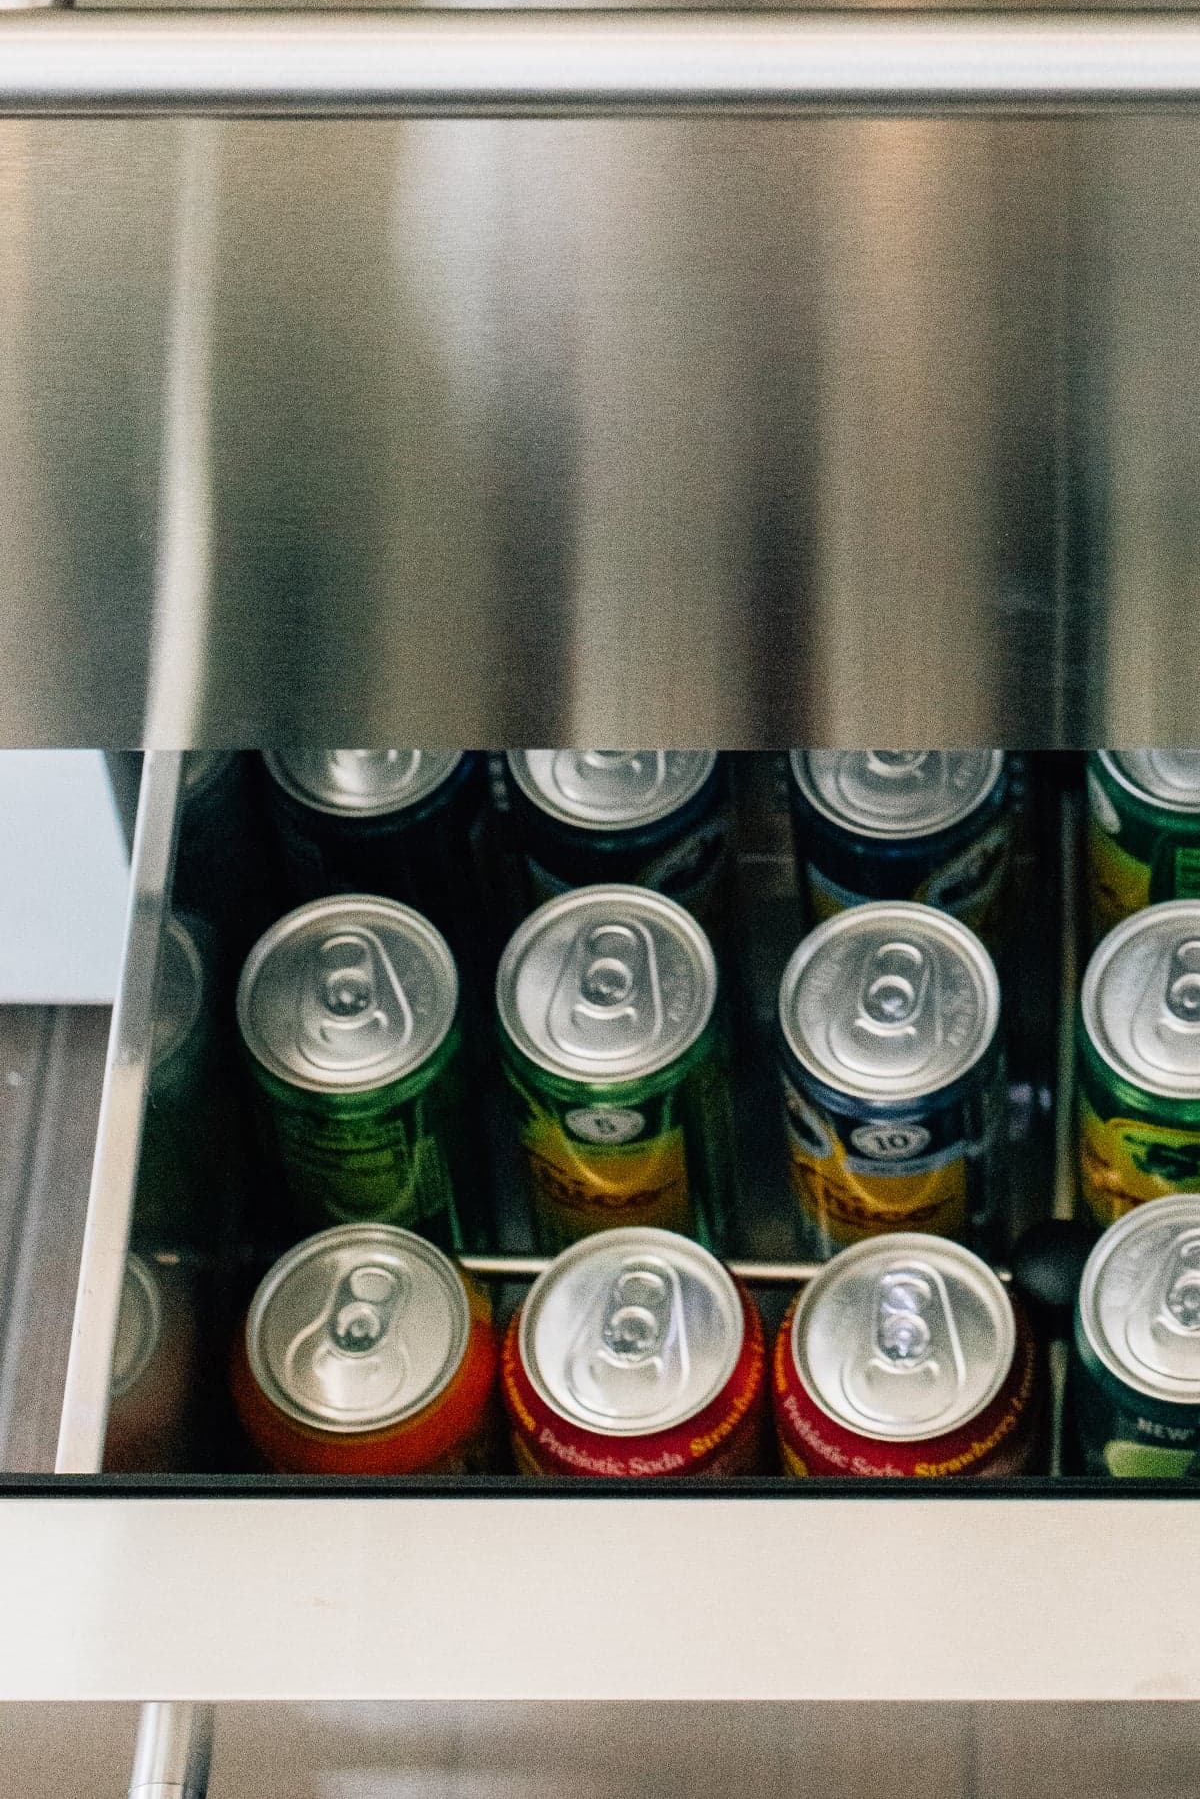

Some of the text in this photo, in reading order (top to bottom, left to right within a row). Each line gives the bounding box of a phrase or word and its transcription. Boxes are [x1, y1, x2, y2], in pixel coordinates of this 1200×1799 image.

[539, 1427, 627, 1476] Prebiotic
[628, 1451, 686, 1475] Soda
[783, 1395, 851, 1468] Prebiotic
[914, 1414, 1017, 1477] Strawberry
[1136, 1416, 1195, 1442] NEW
